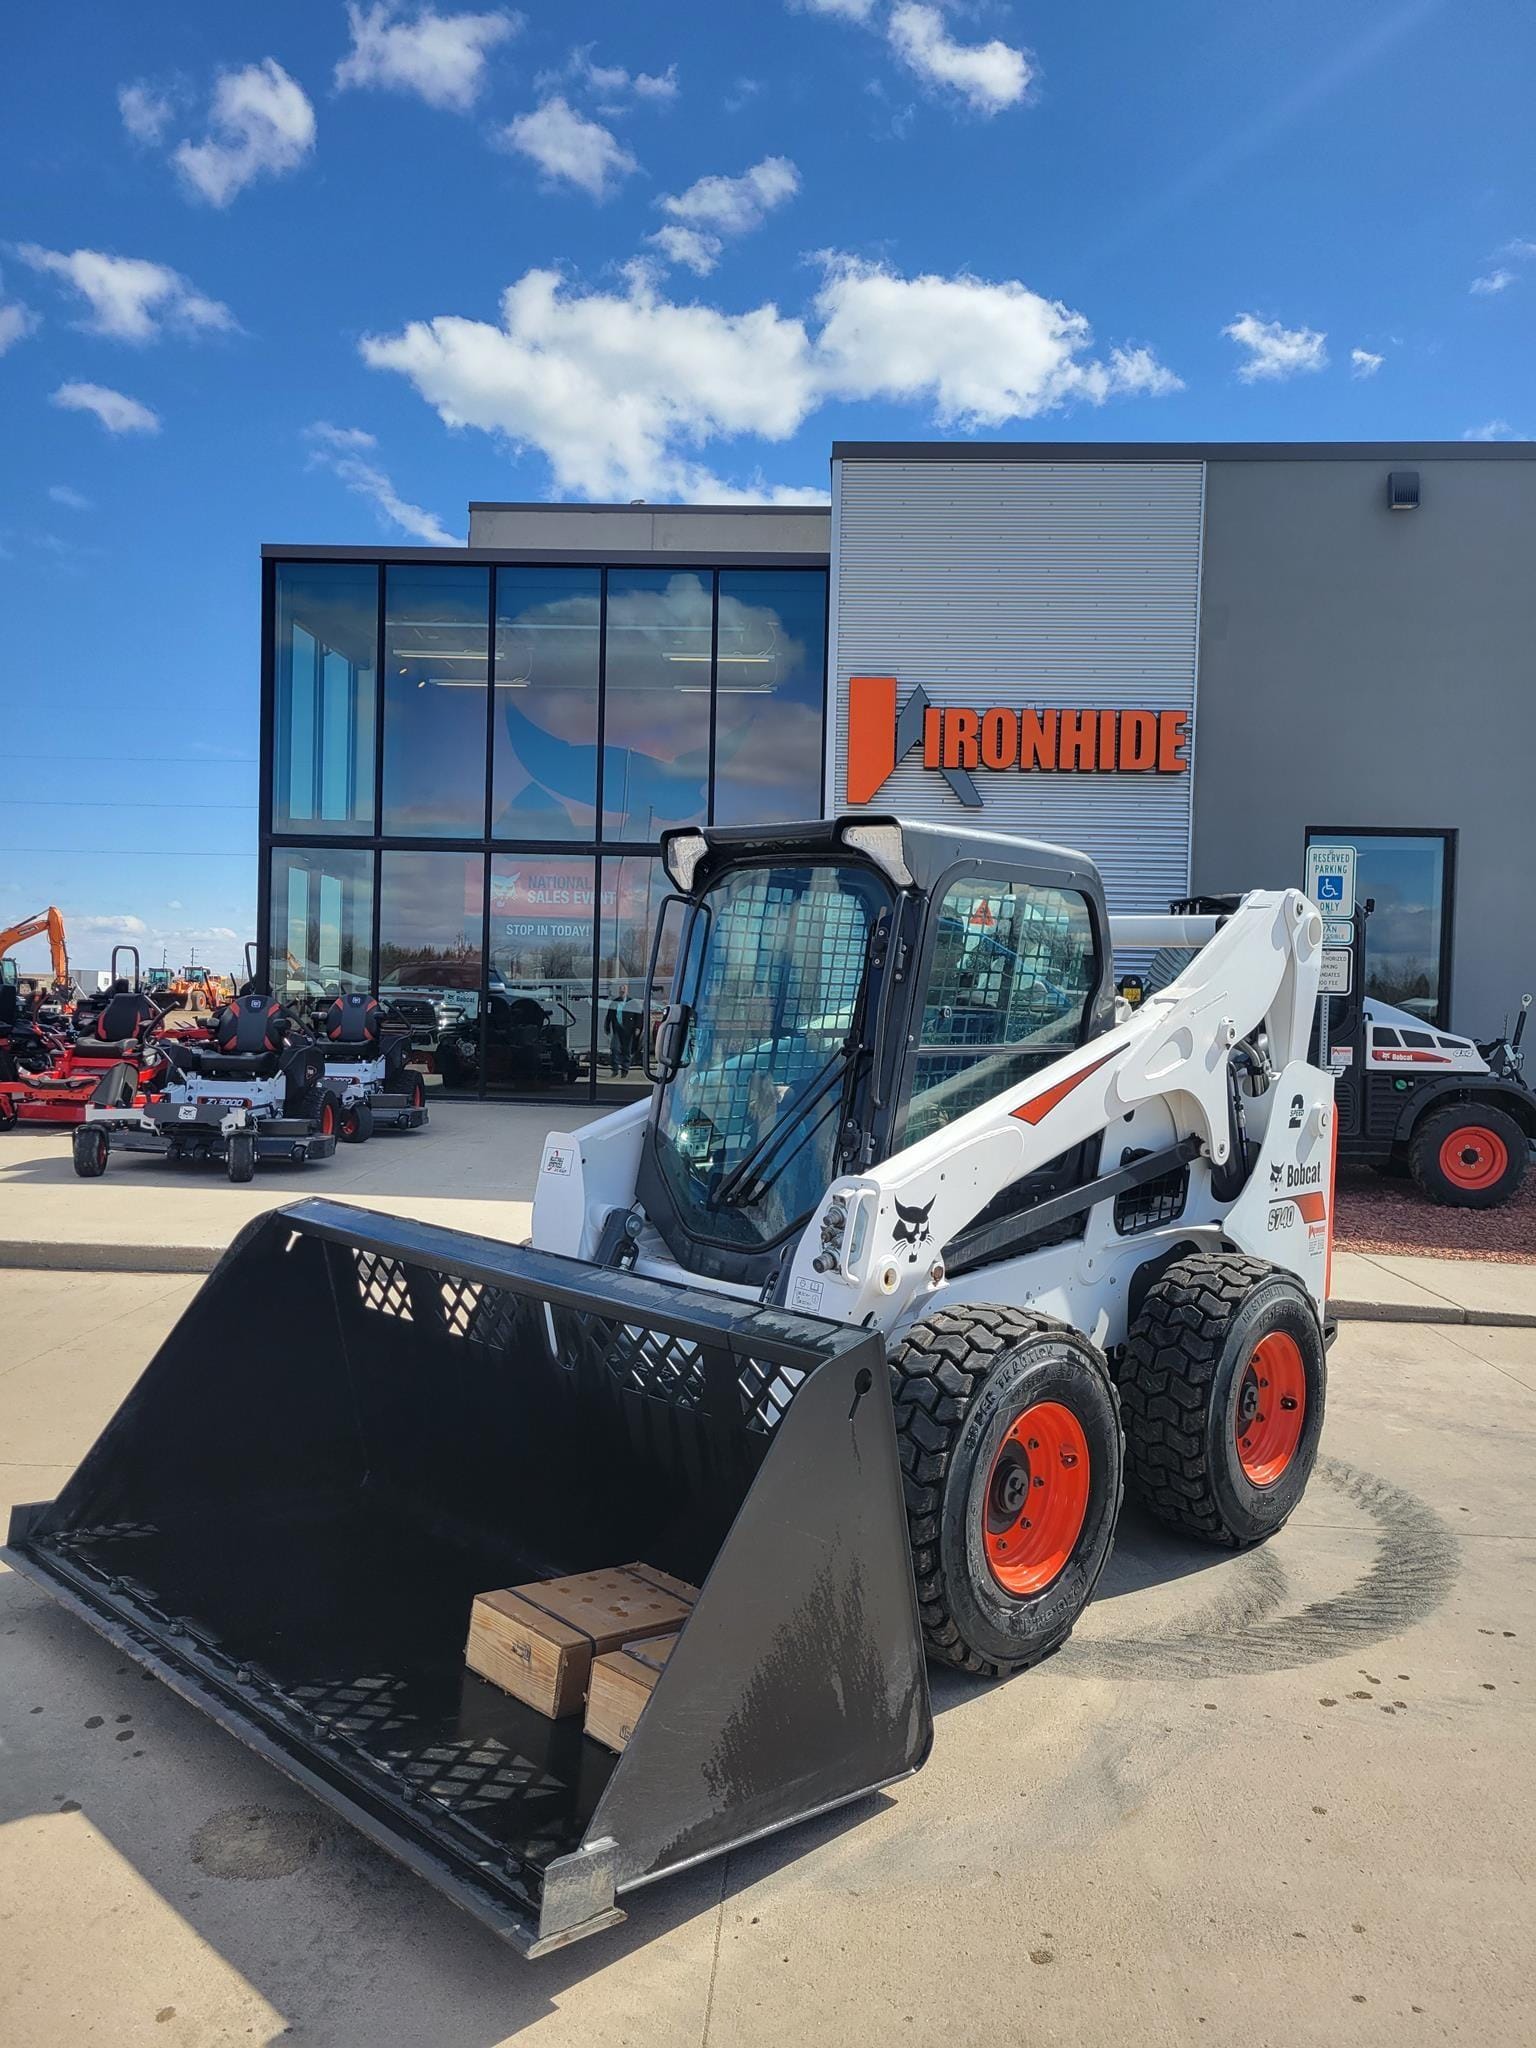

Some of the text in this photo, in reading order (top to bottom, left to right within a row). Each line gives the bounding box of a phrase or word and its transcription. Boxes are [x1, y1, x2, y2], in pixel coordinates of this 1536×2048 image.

[923, 707, 1188, 773] IRONHIDE
[1312, 853, 1350, 863] RESERVED
[1314, 864, 1348, 874] PARKING
[527, 875, 593, 889] NATIONAL
[527, 889, 617, 905] SALES EVNT
[1319, 902, 1340, 911] ONLY
[506, 923, 590, 937] STOP IN TODAY!
[1391, 1053, 1413, 1061] Bobcat
[1286, 1161, 1321, 1188] Bobcat
[1267, 1205, 1295, 1232] S740
